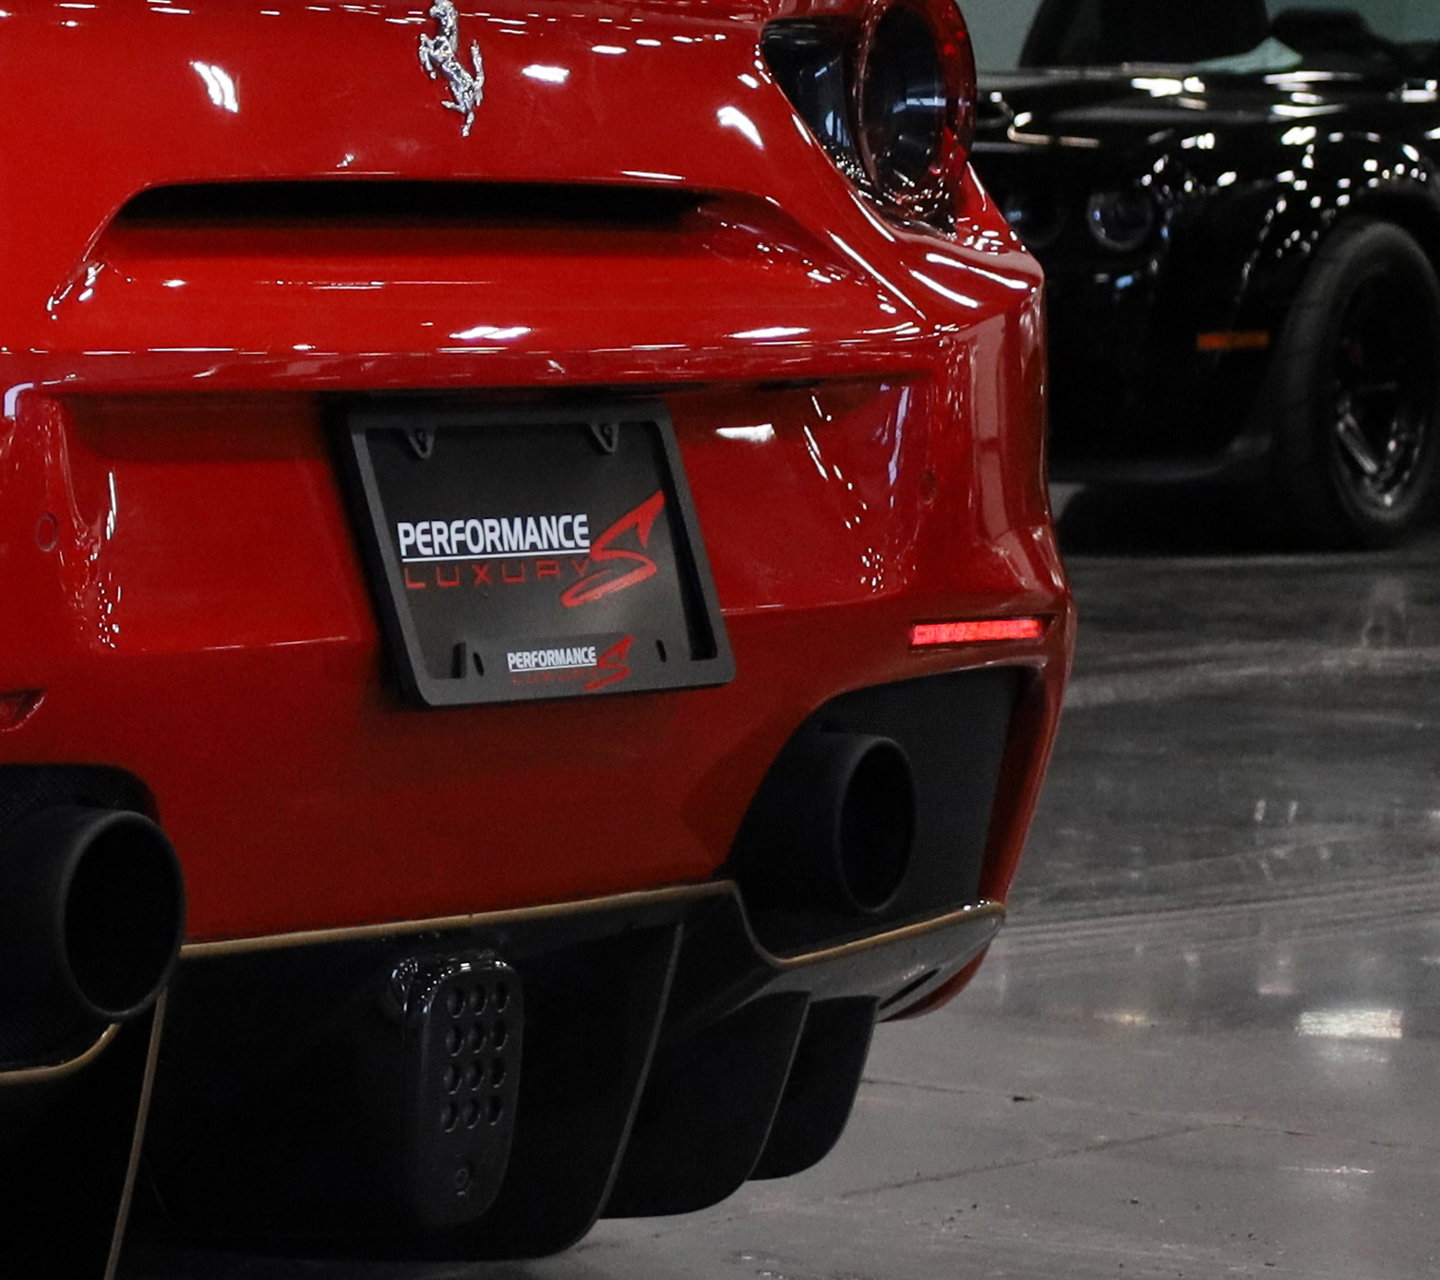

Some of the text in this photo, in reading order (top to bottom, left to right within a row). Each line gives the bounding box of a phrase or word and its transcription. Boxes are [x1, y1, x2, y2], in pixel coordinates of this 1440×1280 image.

[397, 514, 590, 556] PERFORMANCE
[404, 558, 589, 589] LUXURY
[507, 646, 597, 671] PERFORMANCE
